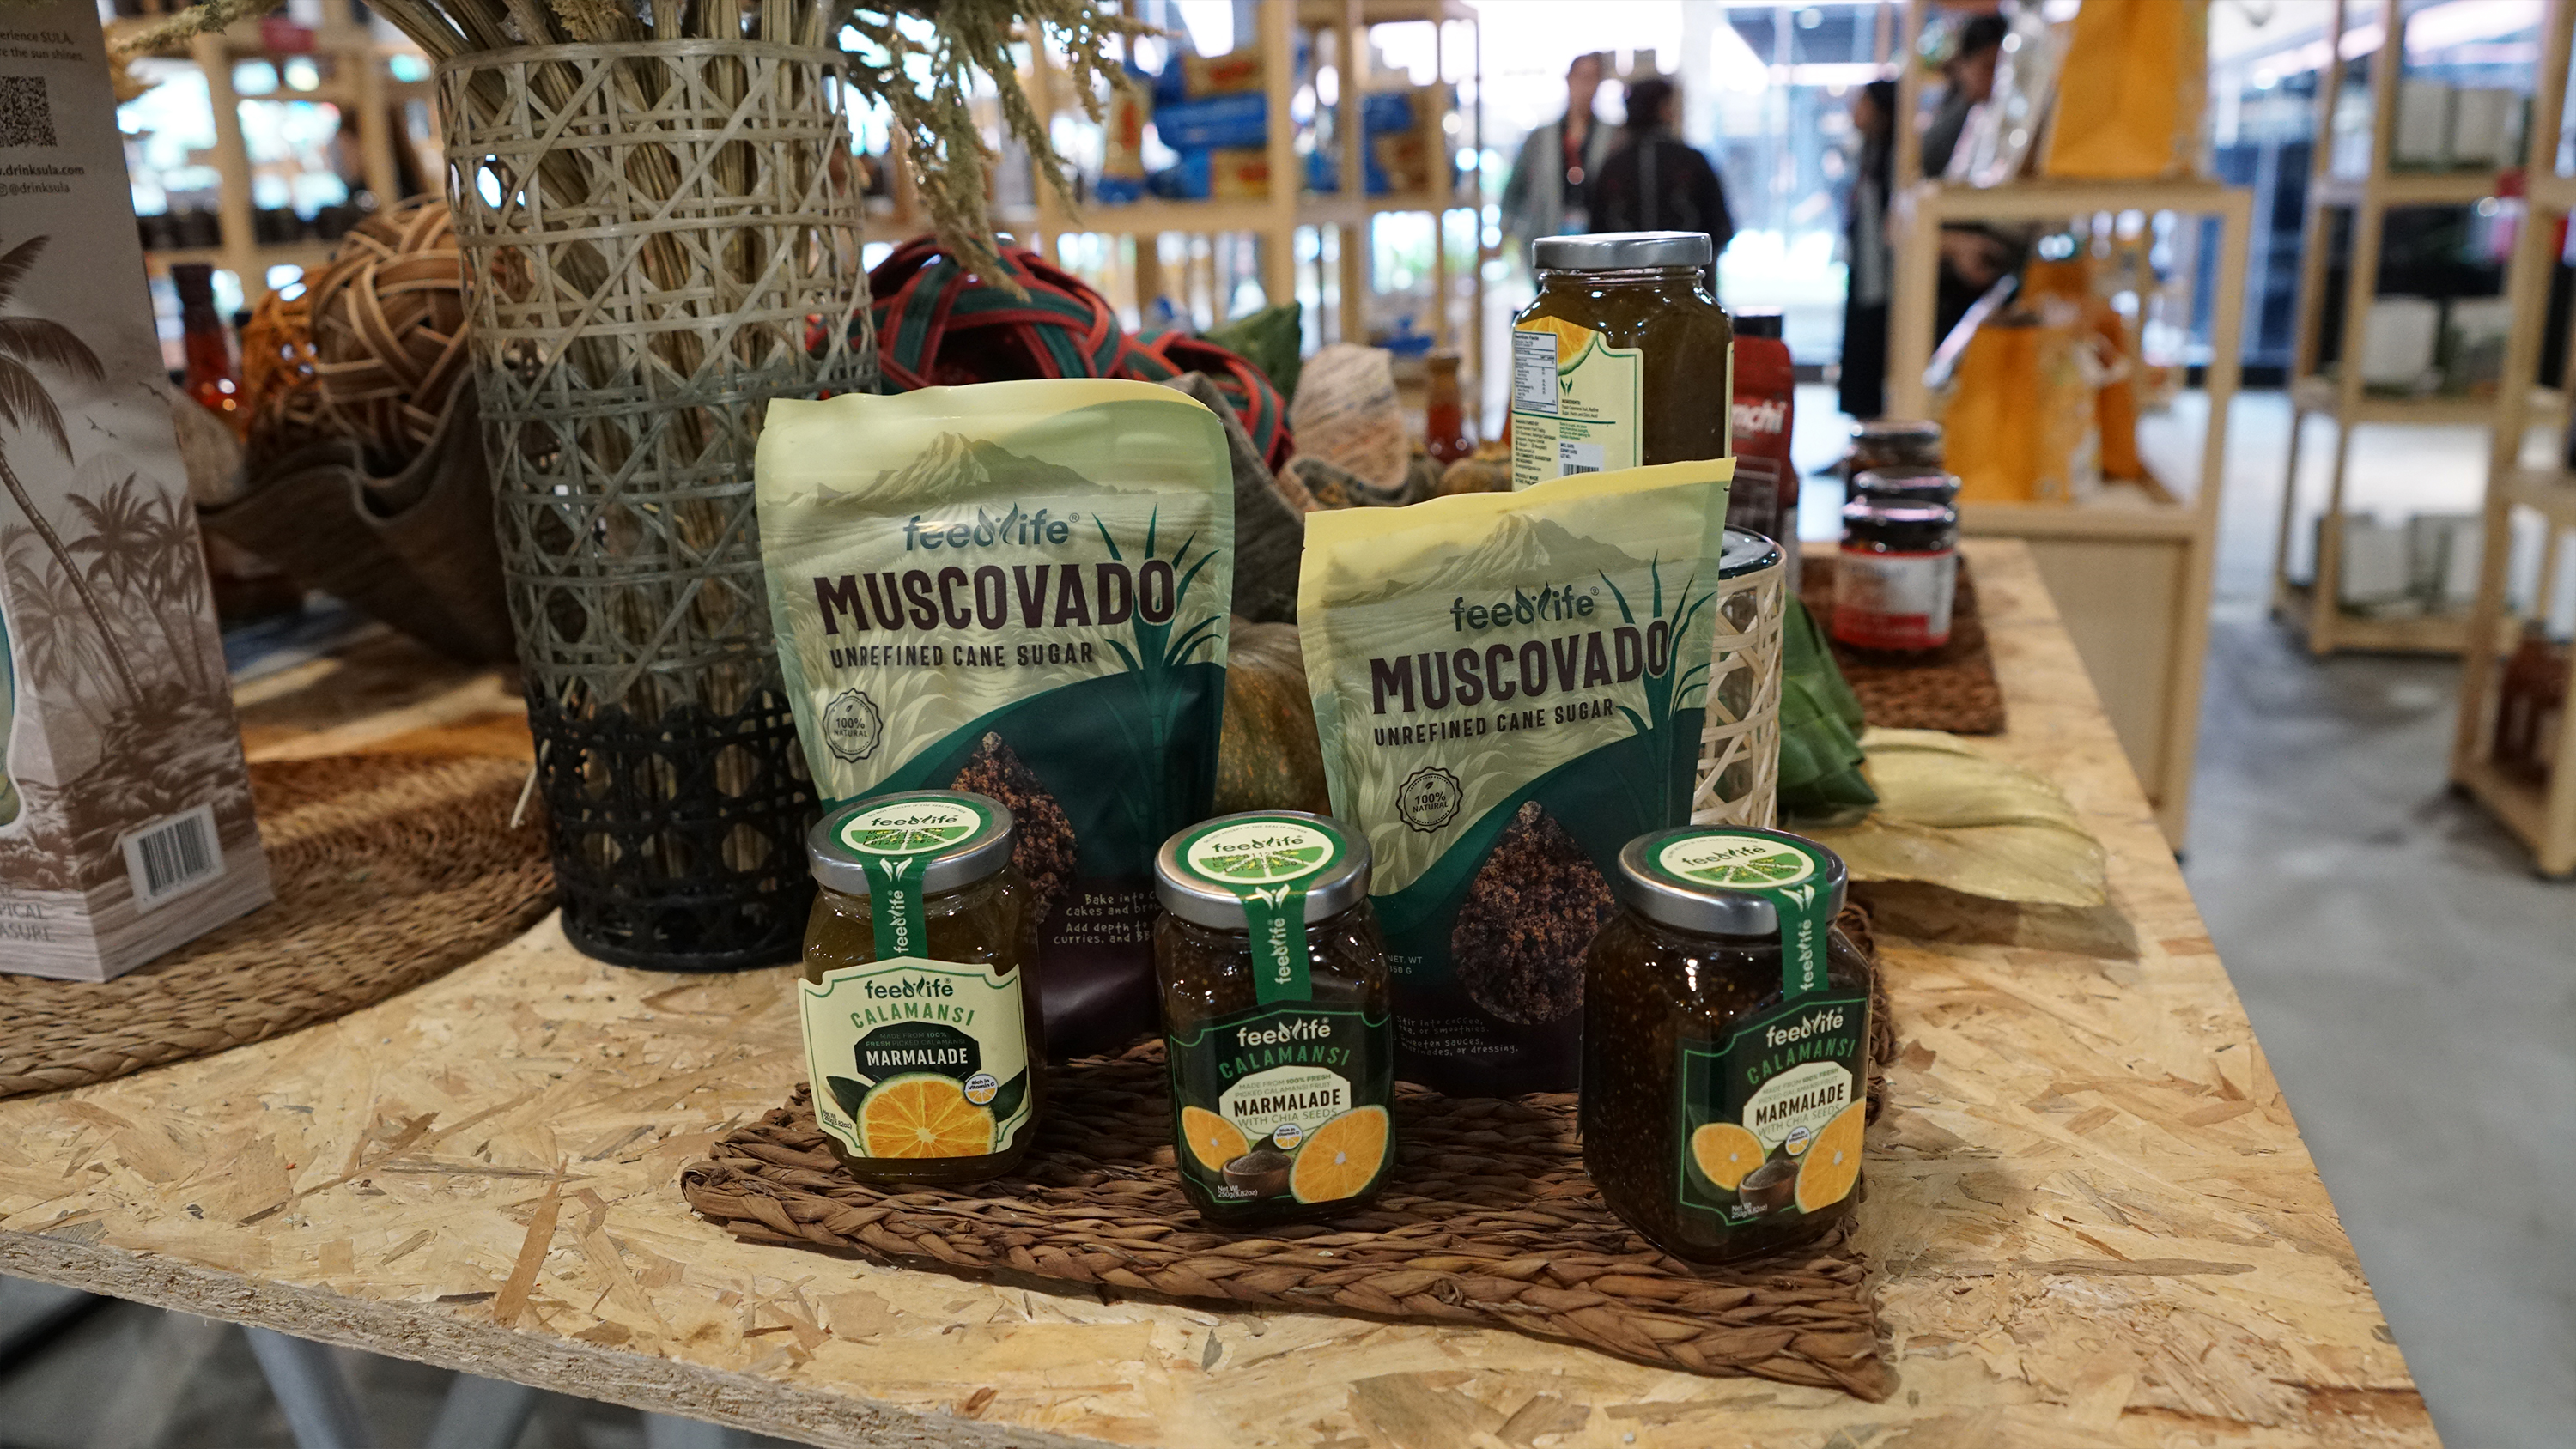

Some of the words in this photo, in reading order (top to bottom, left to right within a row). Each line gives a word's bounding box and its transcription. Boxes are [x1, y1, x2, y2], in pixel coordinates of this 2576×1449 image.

[10, 46, 28, 58] the
[812, 558, 1176, 635] MUSCOVADO
[829, 644, 944, 670] UNREFINED
[953, 644, 1005, 668] CANE
[1017, 641, 1094, 666] SUGAR
[1369, 620, 1669, 715] MUSCOVADO
[836, 718, 866, 729] 100%
[1374, 718, 1487, 747] UNREFINED
[1497, 708, 1546, 733] CANE
[1554, 699, 1613, 724] SUGAR
[1415, 791, 1446, 805] 100%
[1413, 802, 1449, 813] NATURAL
[1084, 894, 1115, 905] Bake
[1120, 891, 1144, 903] into
[1066, 906, 1103, 917] cakes
[1108, 905, 1129, 915] and
[1066, 922, 1088, 933] Add
[1094, 922, 1130, 934] depth
[1135, 920, 1147, 932] to
[1054, 934, 1104, 944] curries,
[1109, 934, 1130, 943] and
[1406, 967, 1412, 975] G
[850, 1003, 975, 1028] CALAMANSI
[1396, 1015, 1415, 1027] Stir
[1420, 1019, 1441, 1028] into
[1434, 1026, 1489, 1034] smoothies.
[1401, 1034, 1441, 1049] Sweeten
[1444, 1038, 1484, 1046] sauces,
[1401, 1042, 1453, 1056] marinades,
[1471, 1045, 1518, 1054] dressing.
[866, 1047, 969, 1066] MARMALADE
[1219, 1046, 1350, 1078] CALAMANSI
[1747, 1038, 1856, 1085] CALAMANSI
[1264, 1085, 1309, 1094] CALAMANSI
[1234, 1088, 1340, 1118] MARMALADE
[1756, 1082, 1844, 1126] MARMALADE
[1238, 1116, 1267, 1127] WITH
[1271, 1113, 1298, 1123] CHIA
[1303, 1107, 1337, 1119] SEEDS
[1759, 1122, 1783, 1137] WITH
[1786, 1113, 1809, 1128] CHIA
[1812, 1104, 1839, 1119] SEEDS
